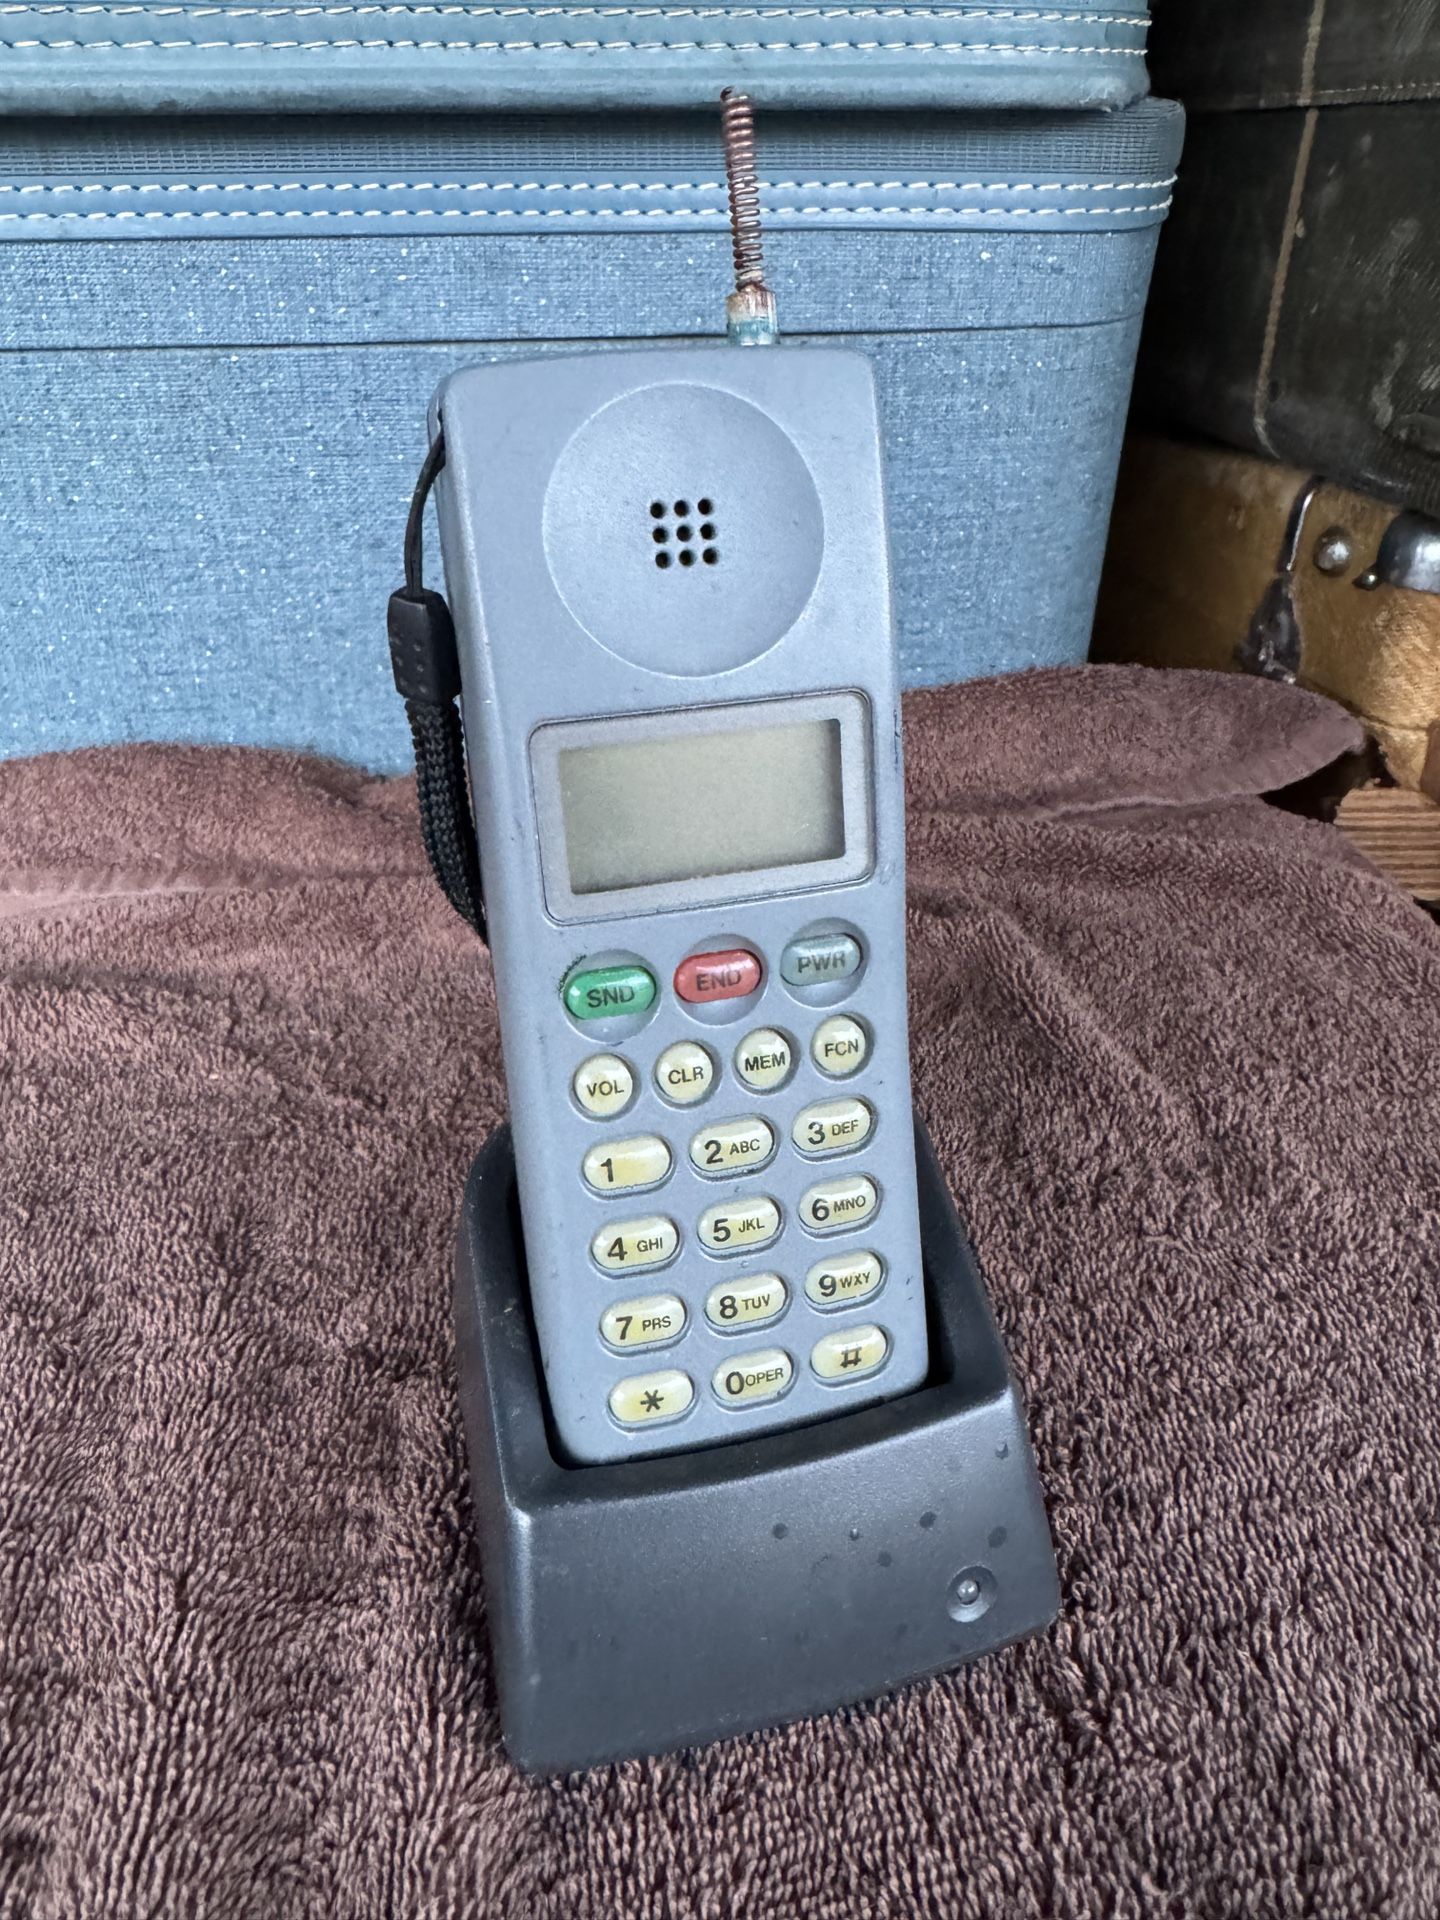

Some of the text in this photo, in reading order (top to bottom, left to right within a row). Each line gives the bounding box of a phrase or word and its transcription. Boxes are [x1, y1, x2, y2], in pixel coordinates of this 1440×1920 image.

[797, 951, 846, 973] PWR
[696, 970, 741, 991] END
[586, 984, 635, 1008] SND
[824, 1039, 859, 1057] FCN
[744, 1052, 786, 1072] MEM
[668, 1066, 704, 1085] CLR
[586, 1079, 625, 1098] VOL
[807, 1119, 860, 1145] 3 DEF
[704, 1138, 760, 1164] 2 ABC
[600, 1158, 614, 1182] 1
[811, 1194, 867, 1222] 6 MNO
[713, 1217, 765, 1242] 5 JKL
[607, 1237, 663, 1261] 4 GHI
[818, 1271, 871, 1297] 9 WXY
[719, 1293, 771, 1319] 8 TUV
[615, 1315, 672, 1340] 7 PRS
[839, 1343, 862, 1368] #
[725, 1367, 784, 1395] 0 OPER
